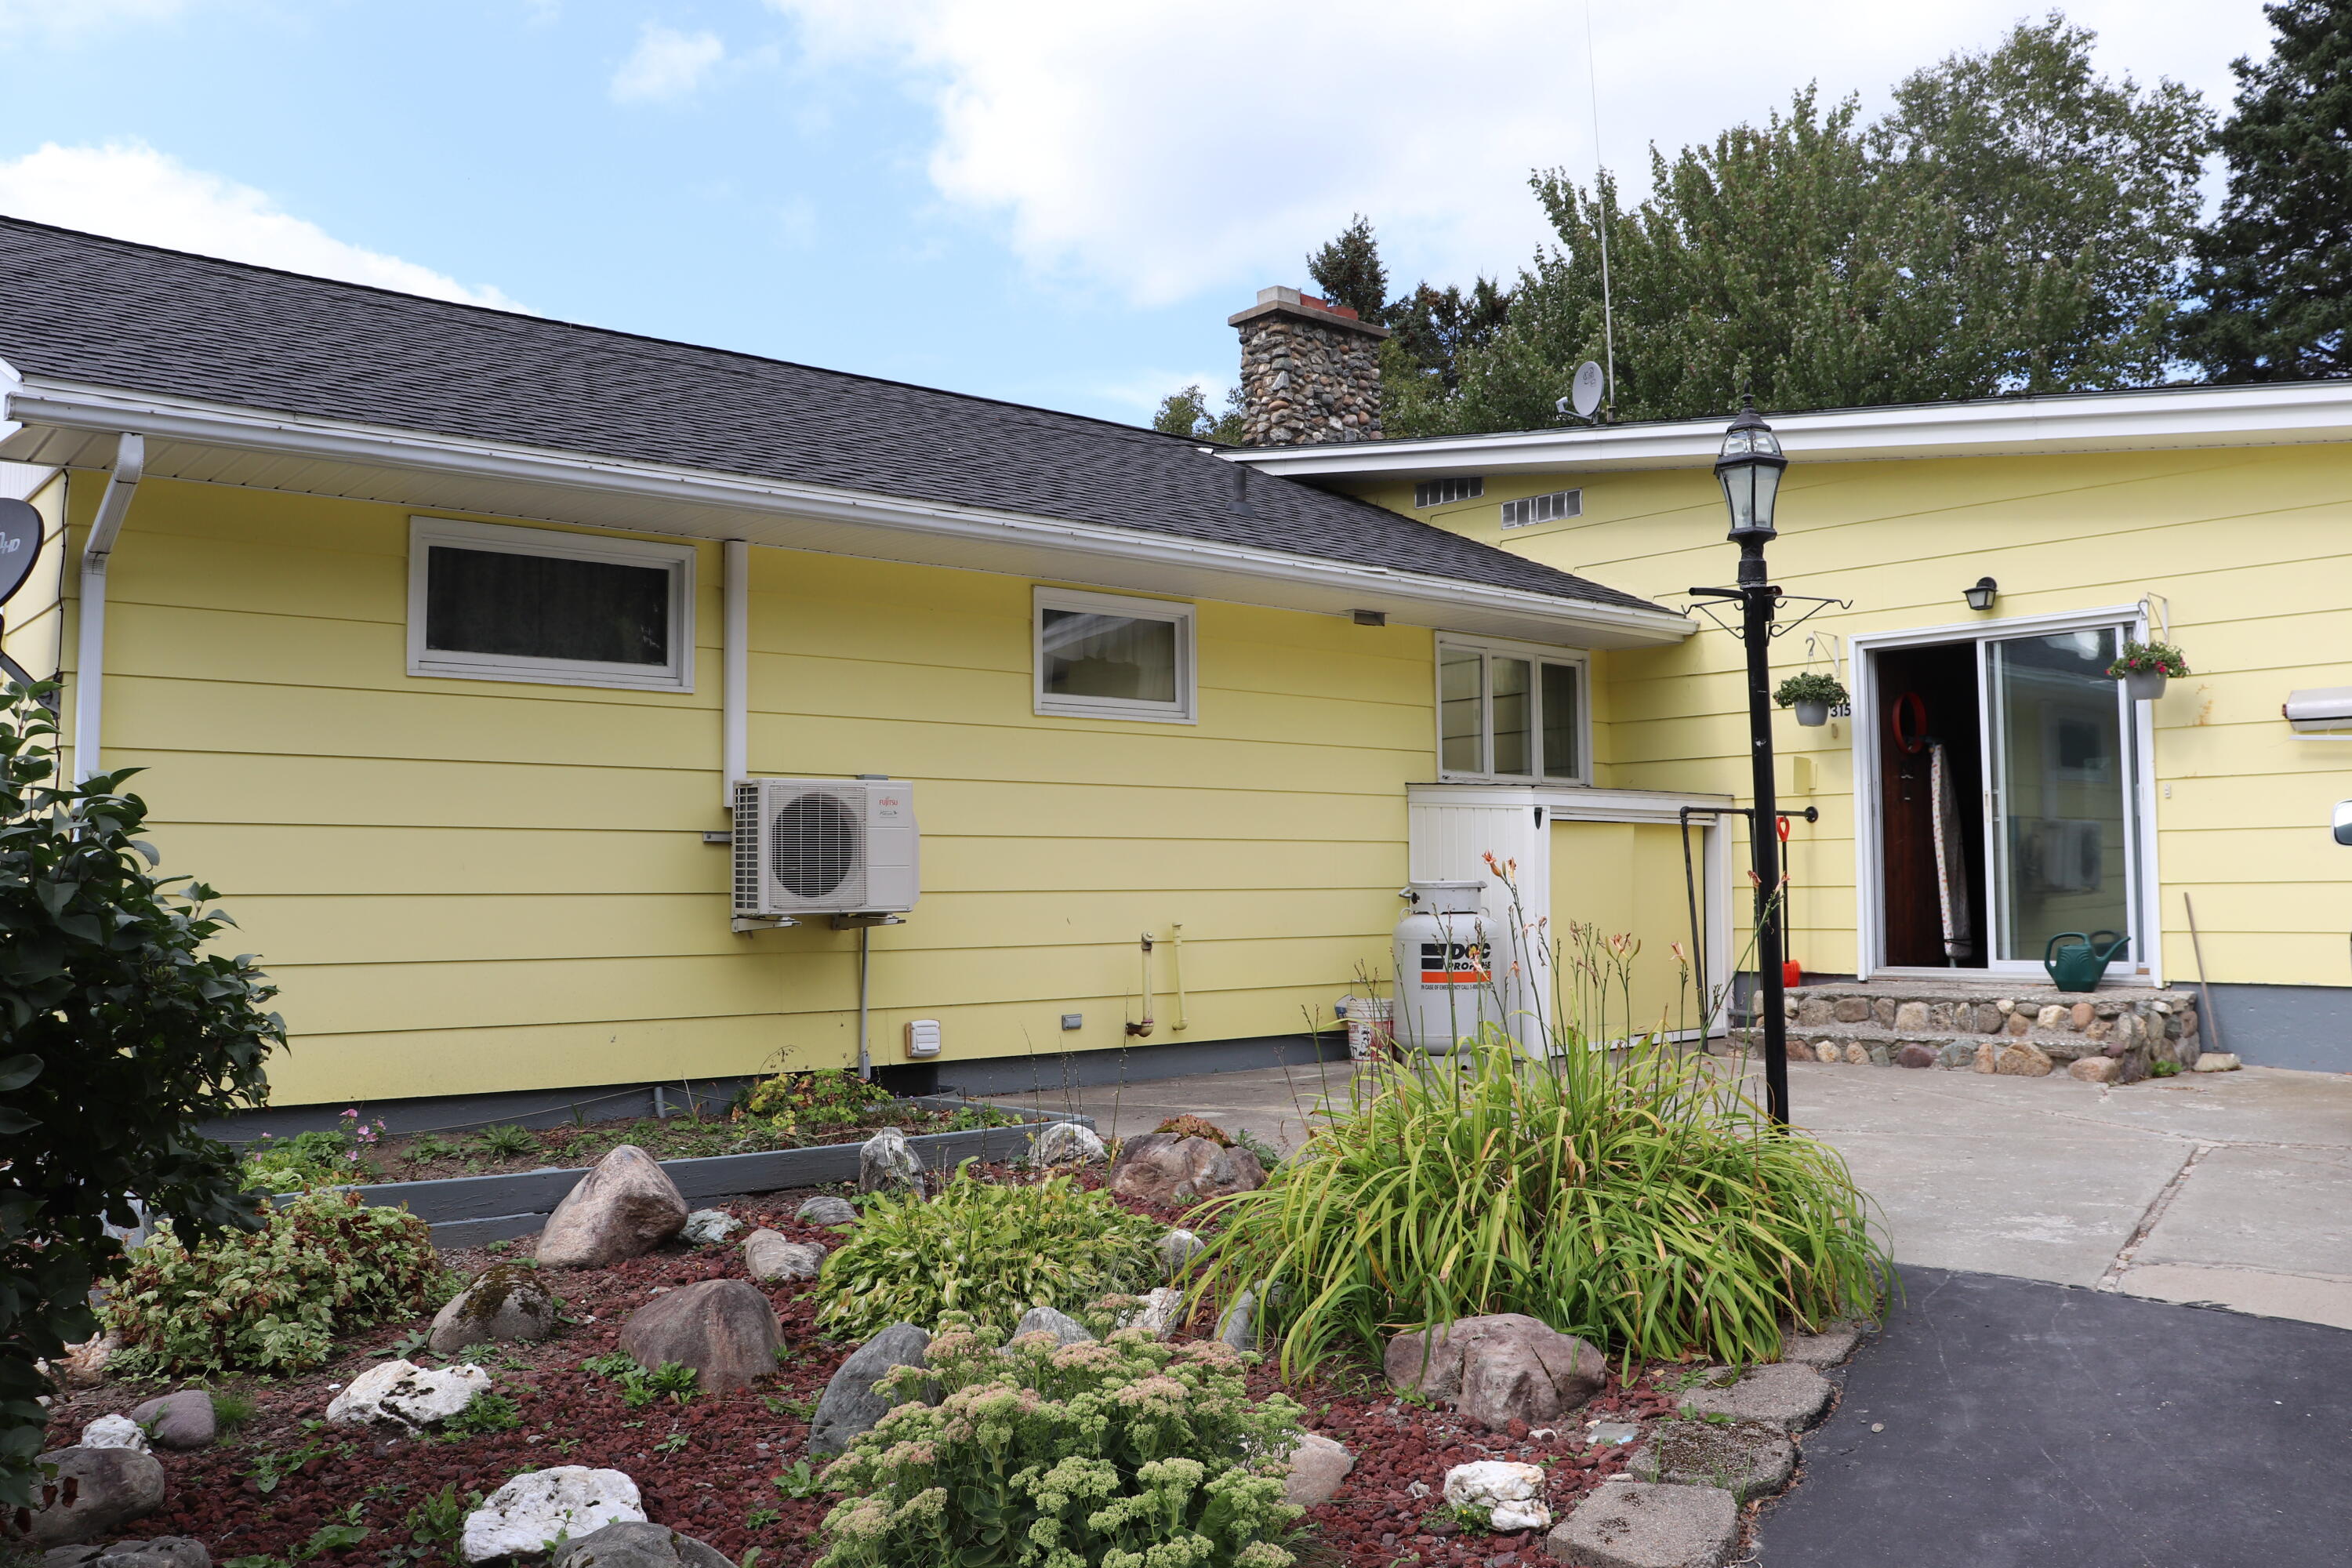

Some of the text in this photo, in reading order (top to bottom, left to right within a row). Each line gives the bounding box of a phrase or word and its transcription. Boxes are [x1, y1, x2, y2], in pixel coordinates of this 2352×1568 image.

[1831, 702, 1851, 717] 315
[879, 798, 898, 807] FUJITSU
[1448, 961, 1491, 971] PROPNE
